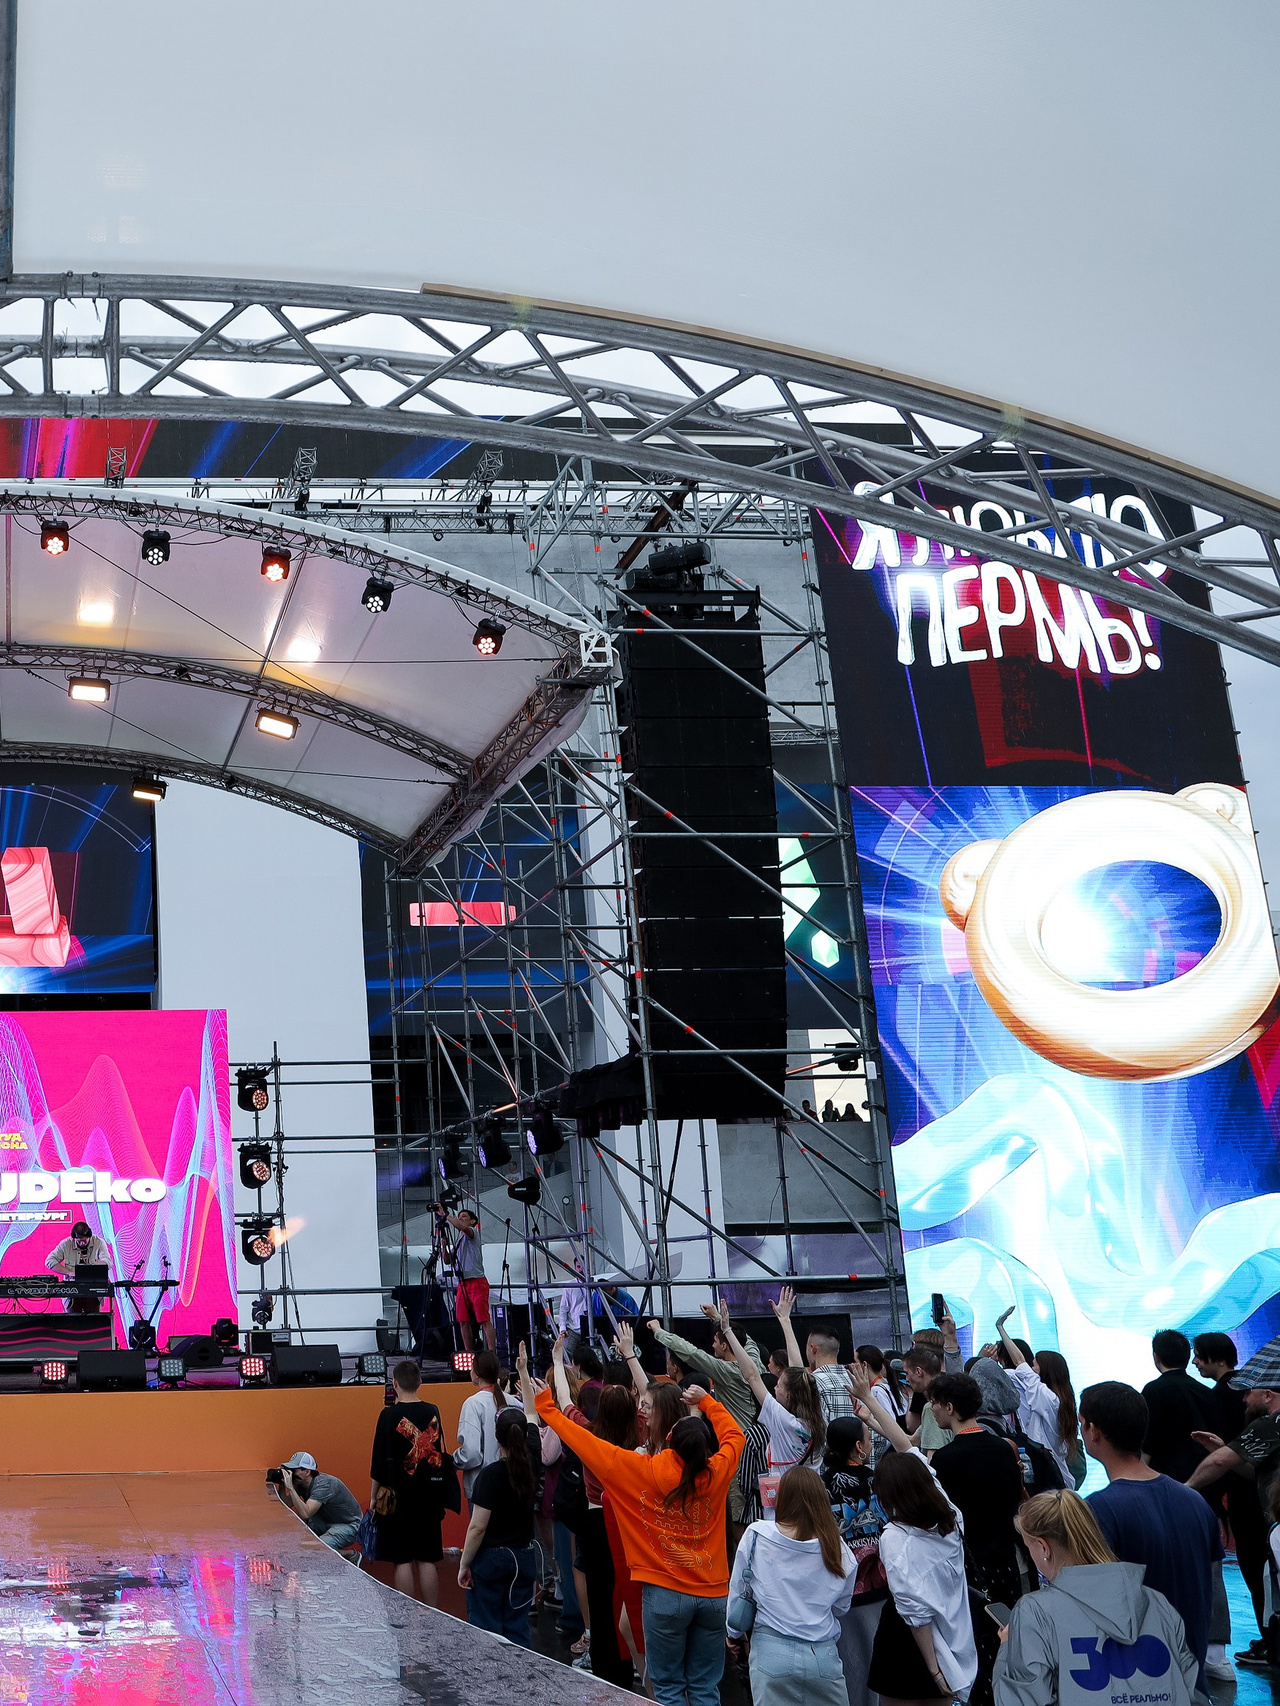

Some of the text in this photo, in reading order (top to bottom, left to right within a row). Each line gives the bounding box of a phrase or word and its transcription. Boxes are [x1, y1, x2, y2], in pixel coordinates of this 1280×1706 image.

[852, 481, 901, 571] Я
[896, 561, 1162, 675] ПЕРМЬ!
[1110, 1693, 1172, 1704] ВСЁ РЕАЛЬНО!
